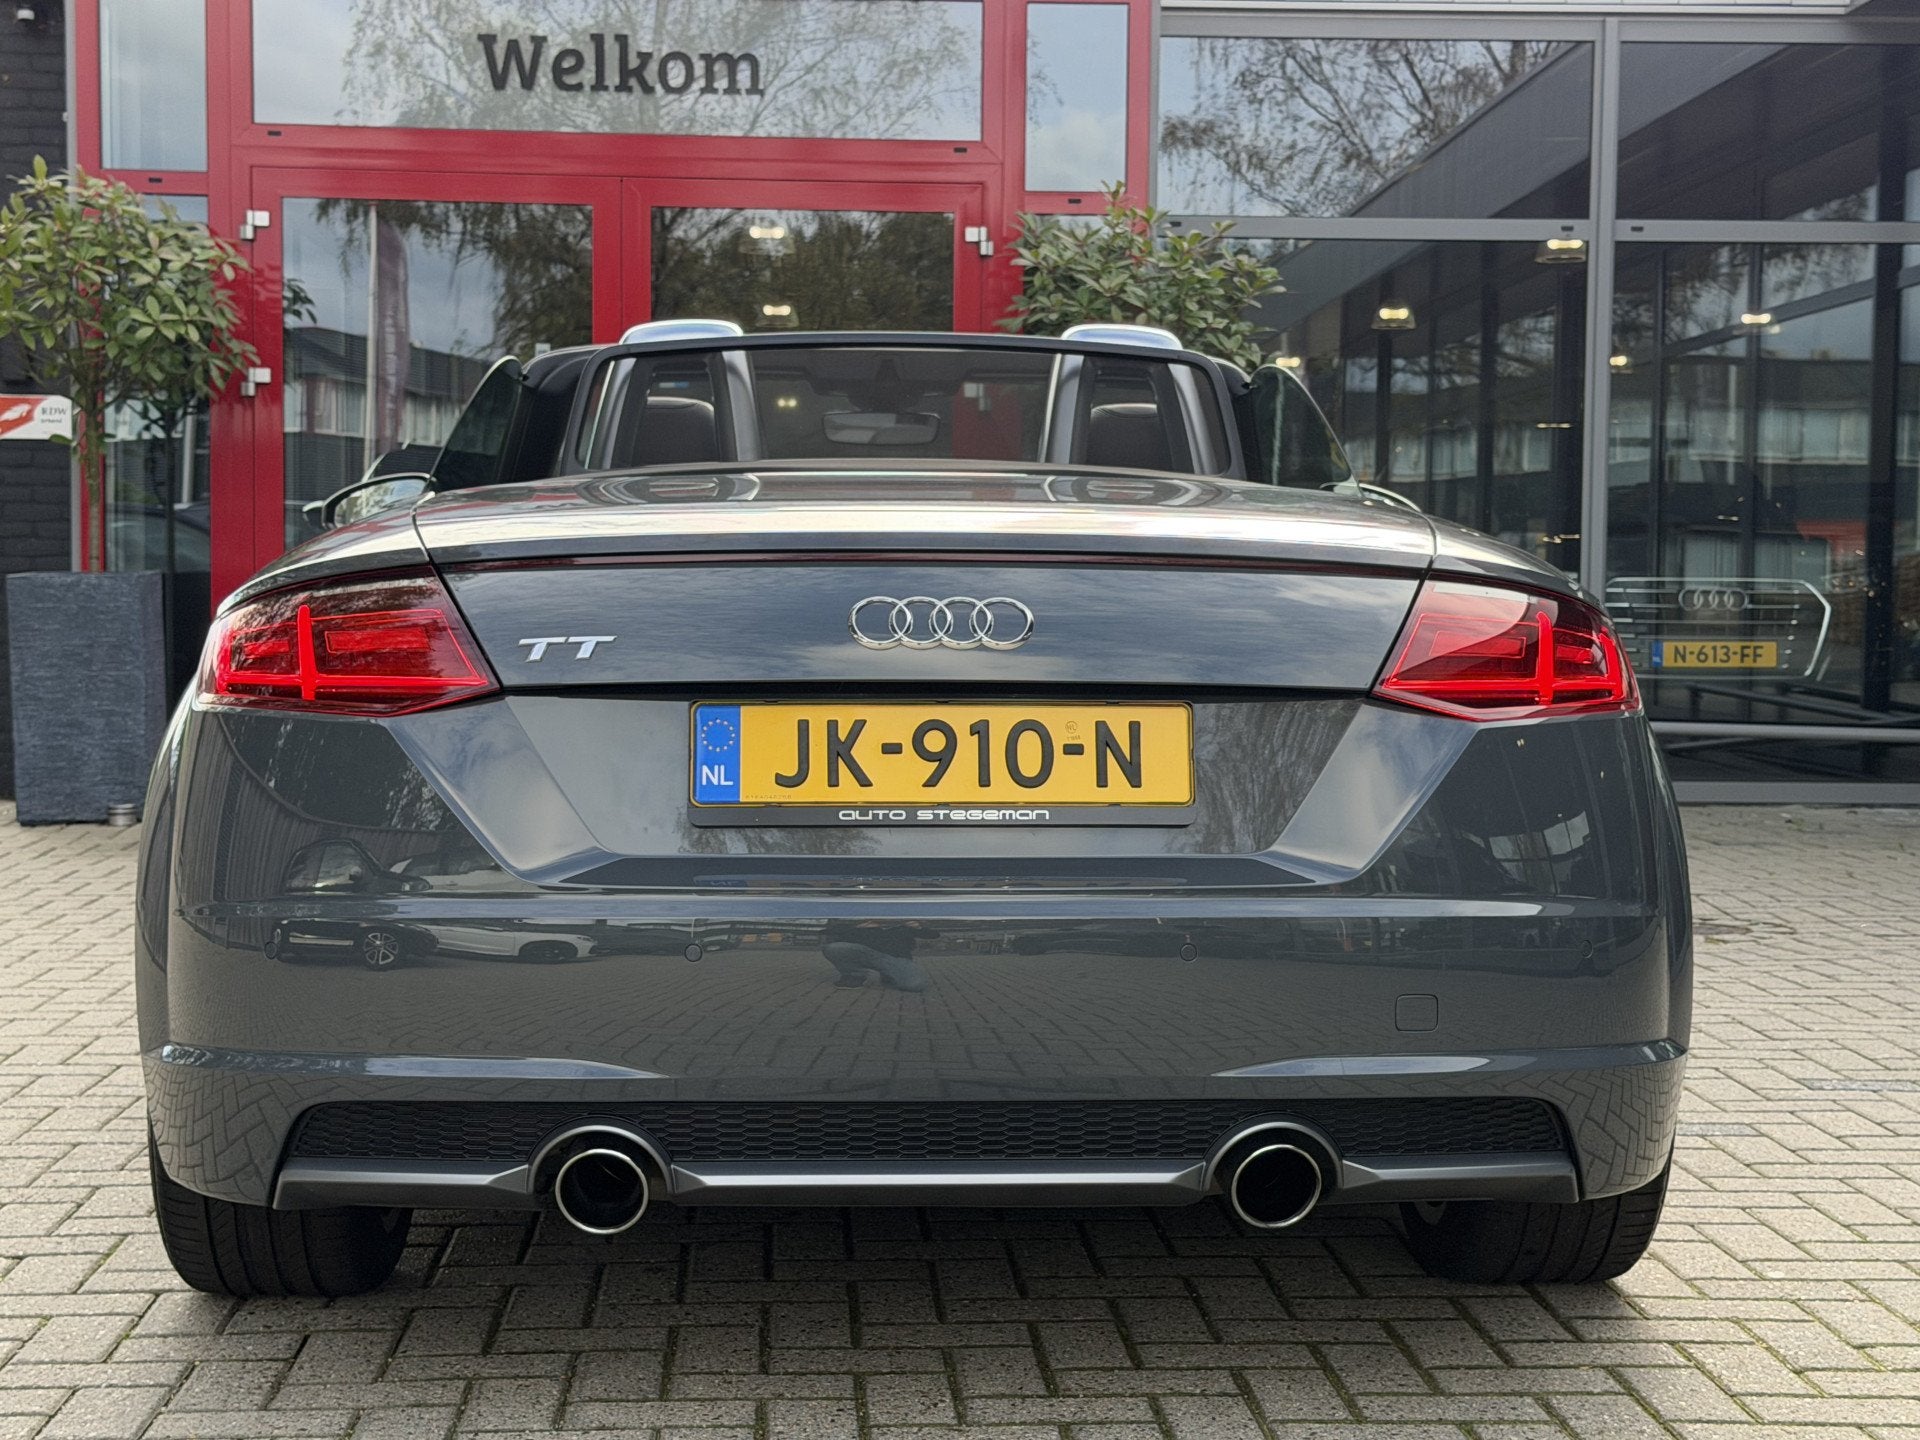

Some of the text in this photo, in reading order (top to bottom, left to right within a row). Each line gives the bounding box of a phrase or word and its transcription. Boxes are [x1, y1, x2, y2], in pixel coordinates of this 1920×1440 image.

[477, 33, 764, 97] Welkom
[518, 635, 618, 662] TT
[1673, 645, 1764, 664] N-613-FF
[774, 718, 1143, 789] JK-910-N
[701, 764, 734, 786] NL
